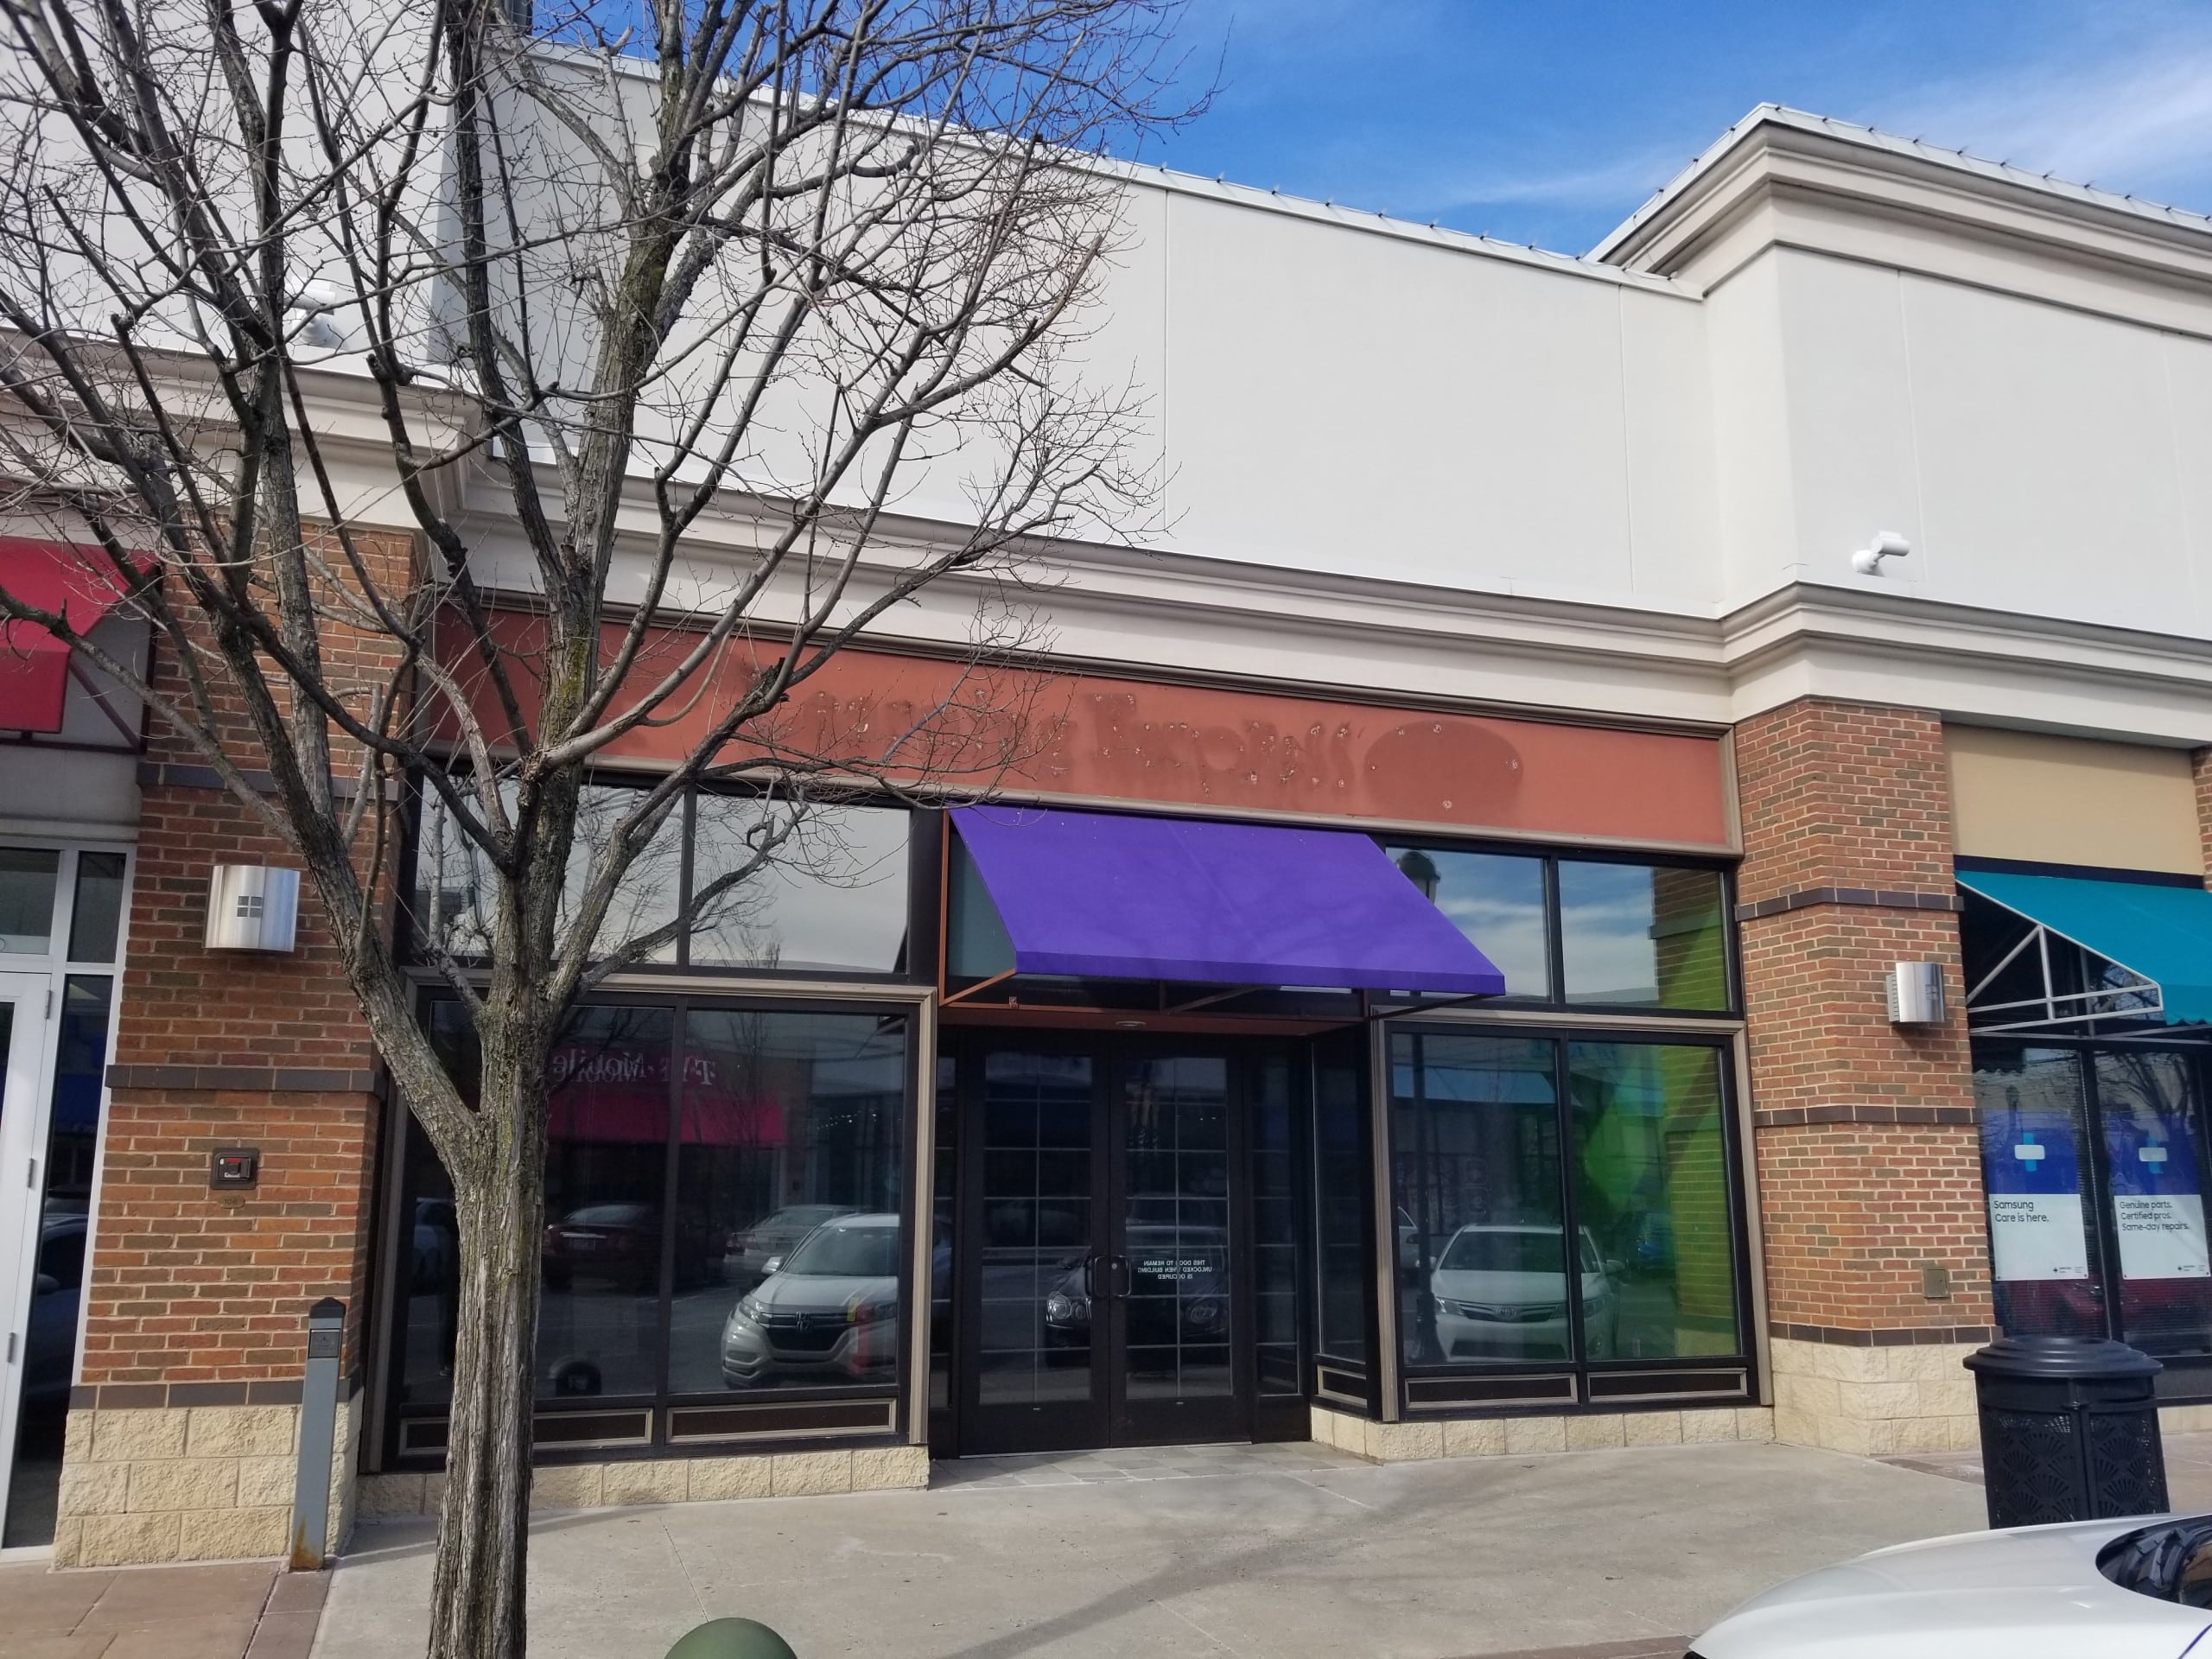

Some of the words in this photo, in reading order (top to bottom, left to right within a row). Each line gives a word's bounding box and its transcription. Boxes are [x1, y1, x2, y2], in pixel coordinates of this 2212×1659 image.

[1993, 1200, 2034, 1211] Samsung
[2120, 1200, 2149, 1209] Genuine
[2151, 1201, 2172, 1210] parts.
[1995, 1213, 2016, 1222] Care
[2018, 1212, 2024, 1222] is
[2026, 1213, 2050, 1222] here.
[2154, 1212, 2171, 1222] pros.
[2122, 1223, 2160, 1232] Same-day
[2162, 1222, 2190, 1232] repairs.
